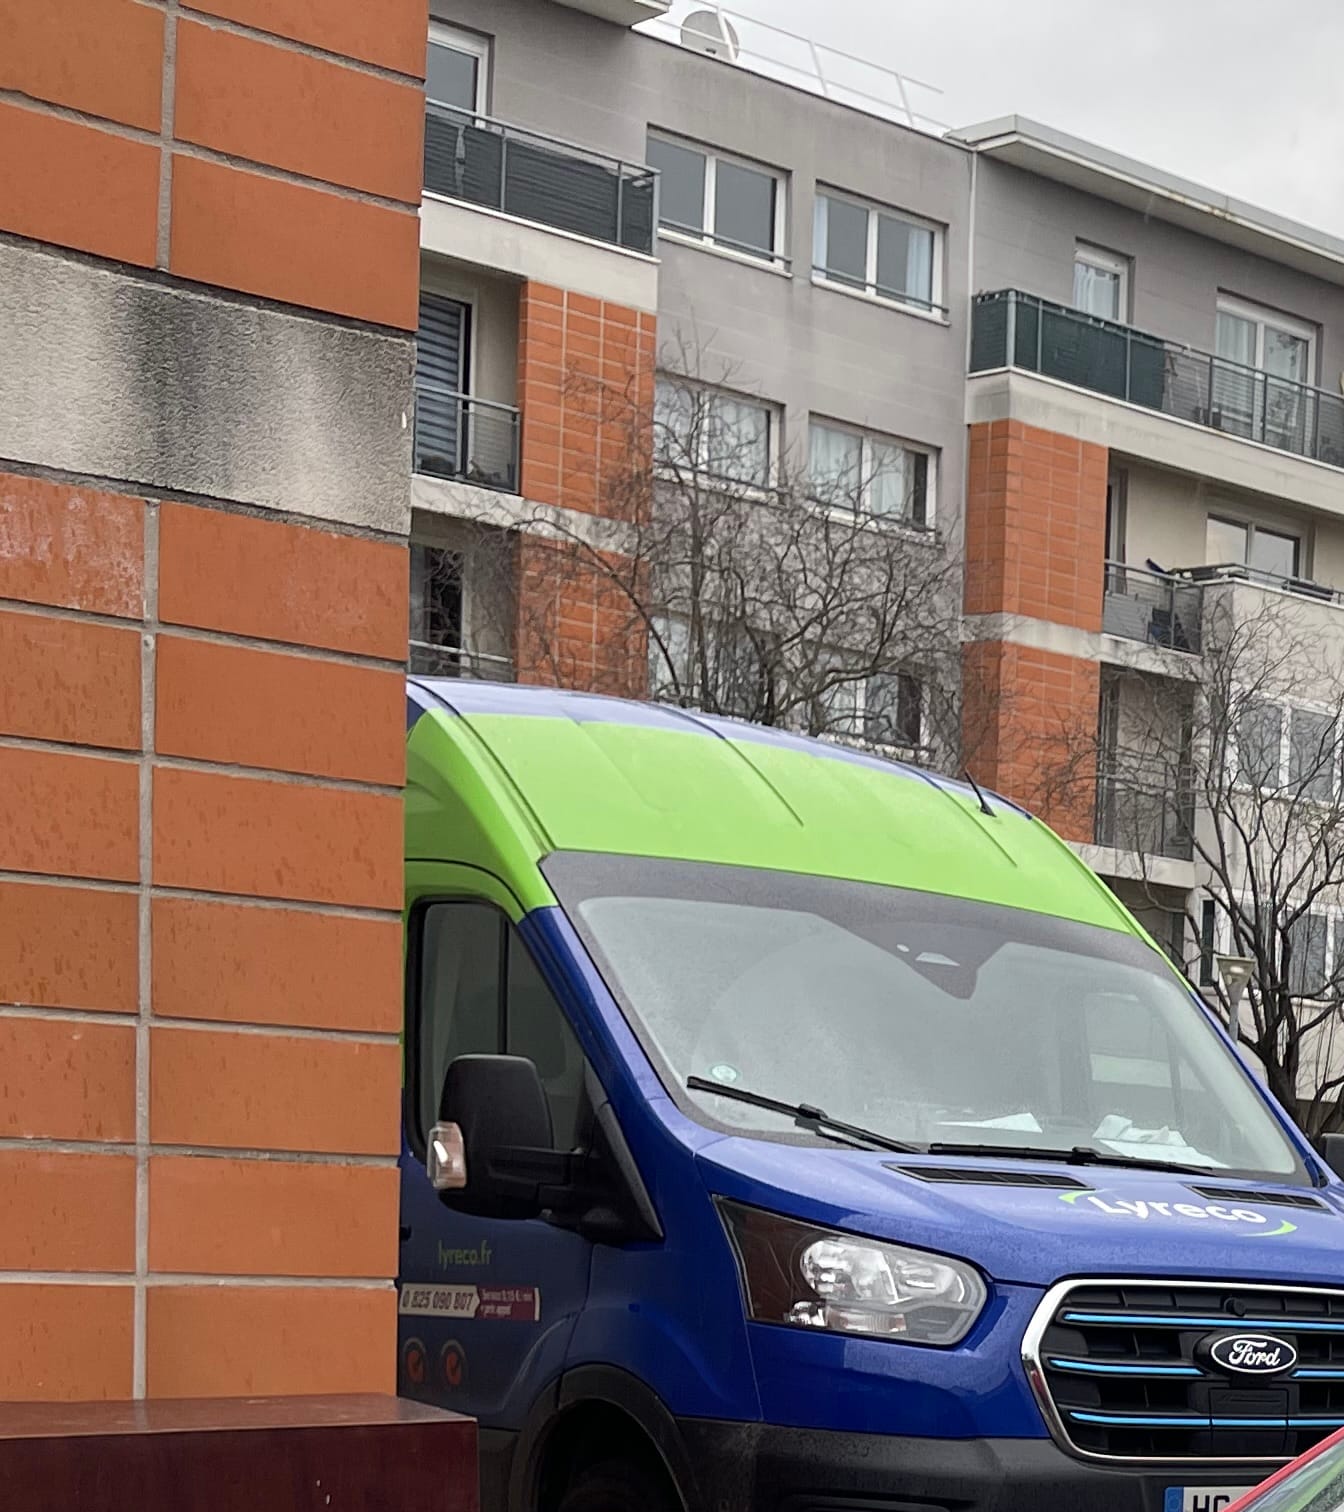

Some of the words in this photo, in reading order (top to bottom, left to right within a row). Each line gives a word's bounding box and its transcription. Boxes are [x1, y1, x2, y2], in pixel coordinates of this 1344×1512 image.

[1087, 1196, 1267, 1224] Lyreco
[438, 1240, 491, 1270] lyreco.fr
[402, 1290, 410, 1308] 0
[411, 1291, 432, 1309] 825
[1228, 1340, 1280, 1366] Ford
